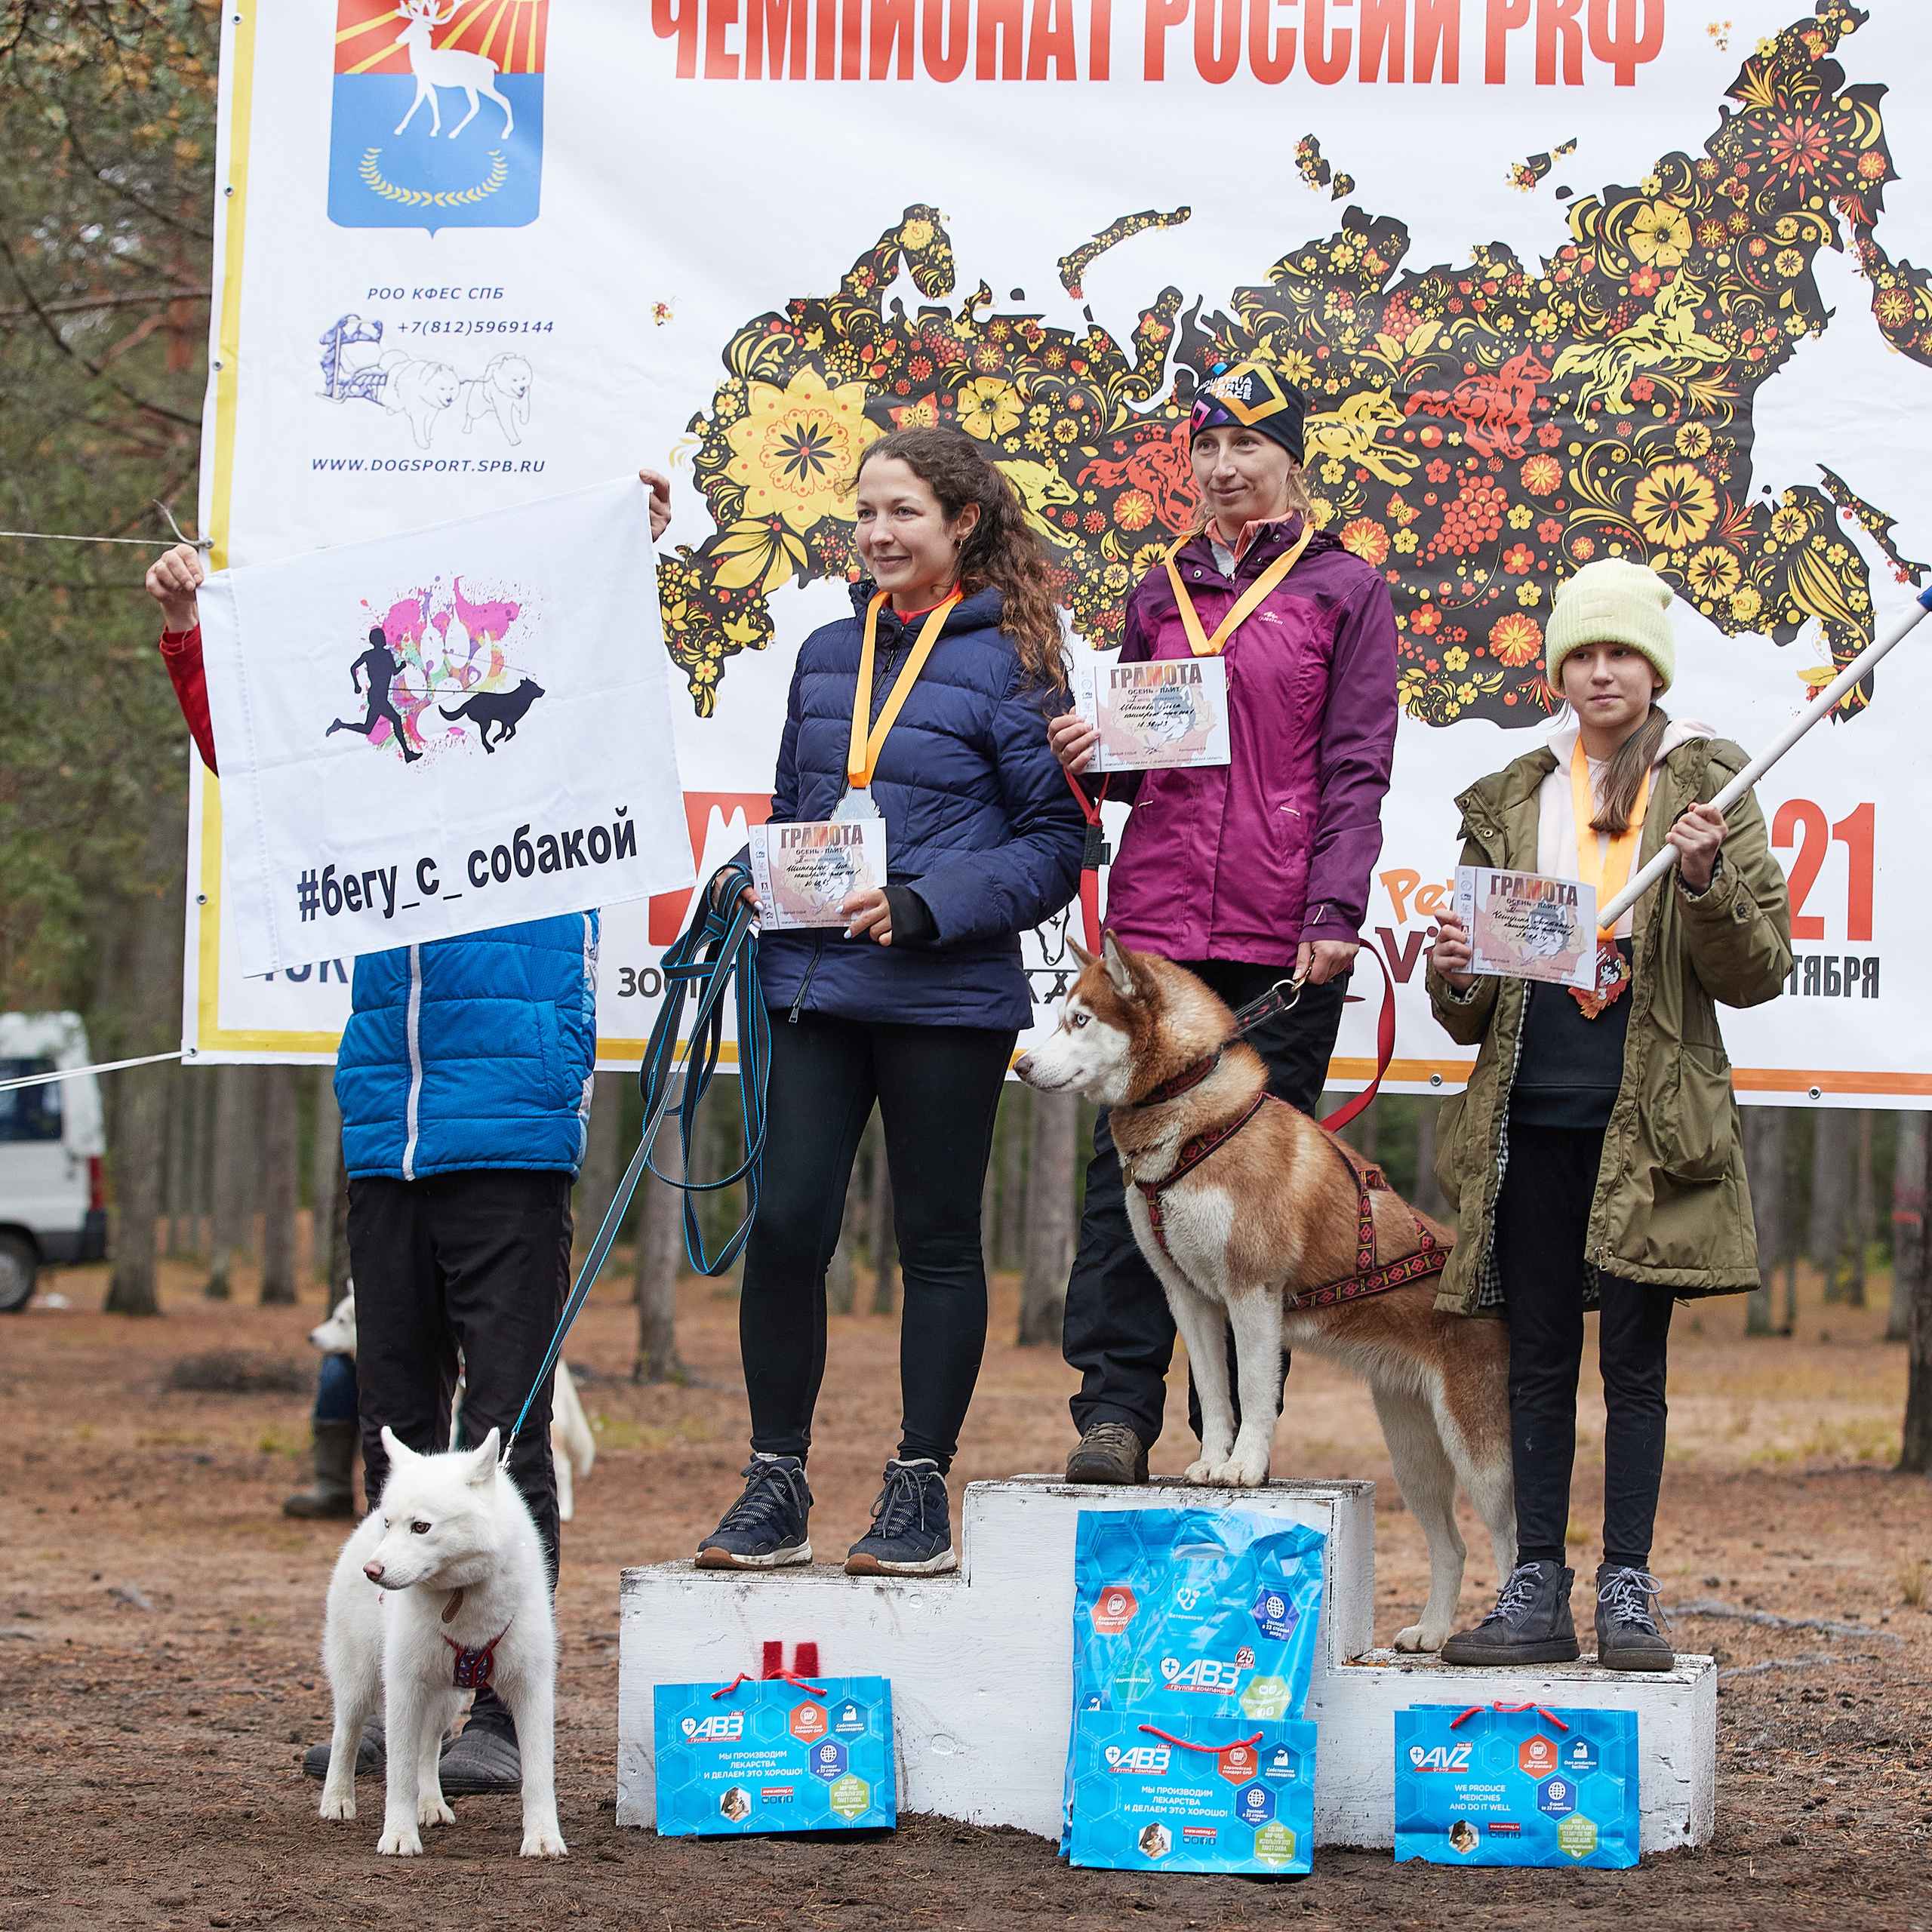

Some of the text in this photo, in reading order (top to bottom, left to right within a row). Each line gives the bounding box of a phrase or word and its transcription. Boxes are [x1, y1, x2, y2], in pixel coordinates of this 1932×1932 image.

[367, 288, 505, 300] РОО КФЕС СПБ
[398, 321, 555, 336] +7(812)5969144
[1215, 390, 1252, 401] RACE
[312, 459, 546, 472] WWW.DOGSPORT.SPB.RU
[1110, 663, 1203, 689] ГРАМОТА
[780, 824, 864, 849] ГРАМОТА
[1491, 875, 1578, 907] ГРАМОТА
[1783, 955, 1880, 999] ТЯБРЯ
[1598, 987, 1607, 1001] 3
[1237, 1651, 1254, 1663] 25
[690, 1716, 744, 1738] АВЗ
[733, 1750, 787, 1759] ПРОИЗВОДИМ
[1112, 1747, 1171, 1770] АВЗ
[1417, 1746, 1472, 1767] AVZ
[730, 1760, 777, 1769] ЛЕКАРСТВА
[711, 1770, 745, 1780] ДЕЛАЕМ
[764, 1768, 803, 1777] ХОРОШО!
[1156, 1786, 1213, 1797] ПРОИЗВОДИМ
[1152, 1796, 1201, 1806] ЛЕКАРСТВА
[1131, 1804, 1167, 1814] ДЕЛАЕМ
[1169, 1806, 1186, 1814] ЭТО
[1187, 1807, 1228, 1817] ХОРОШО!
